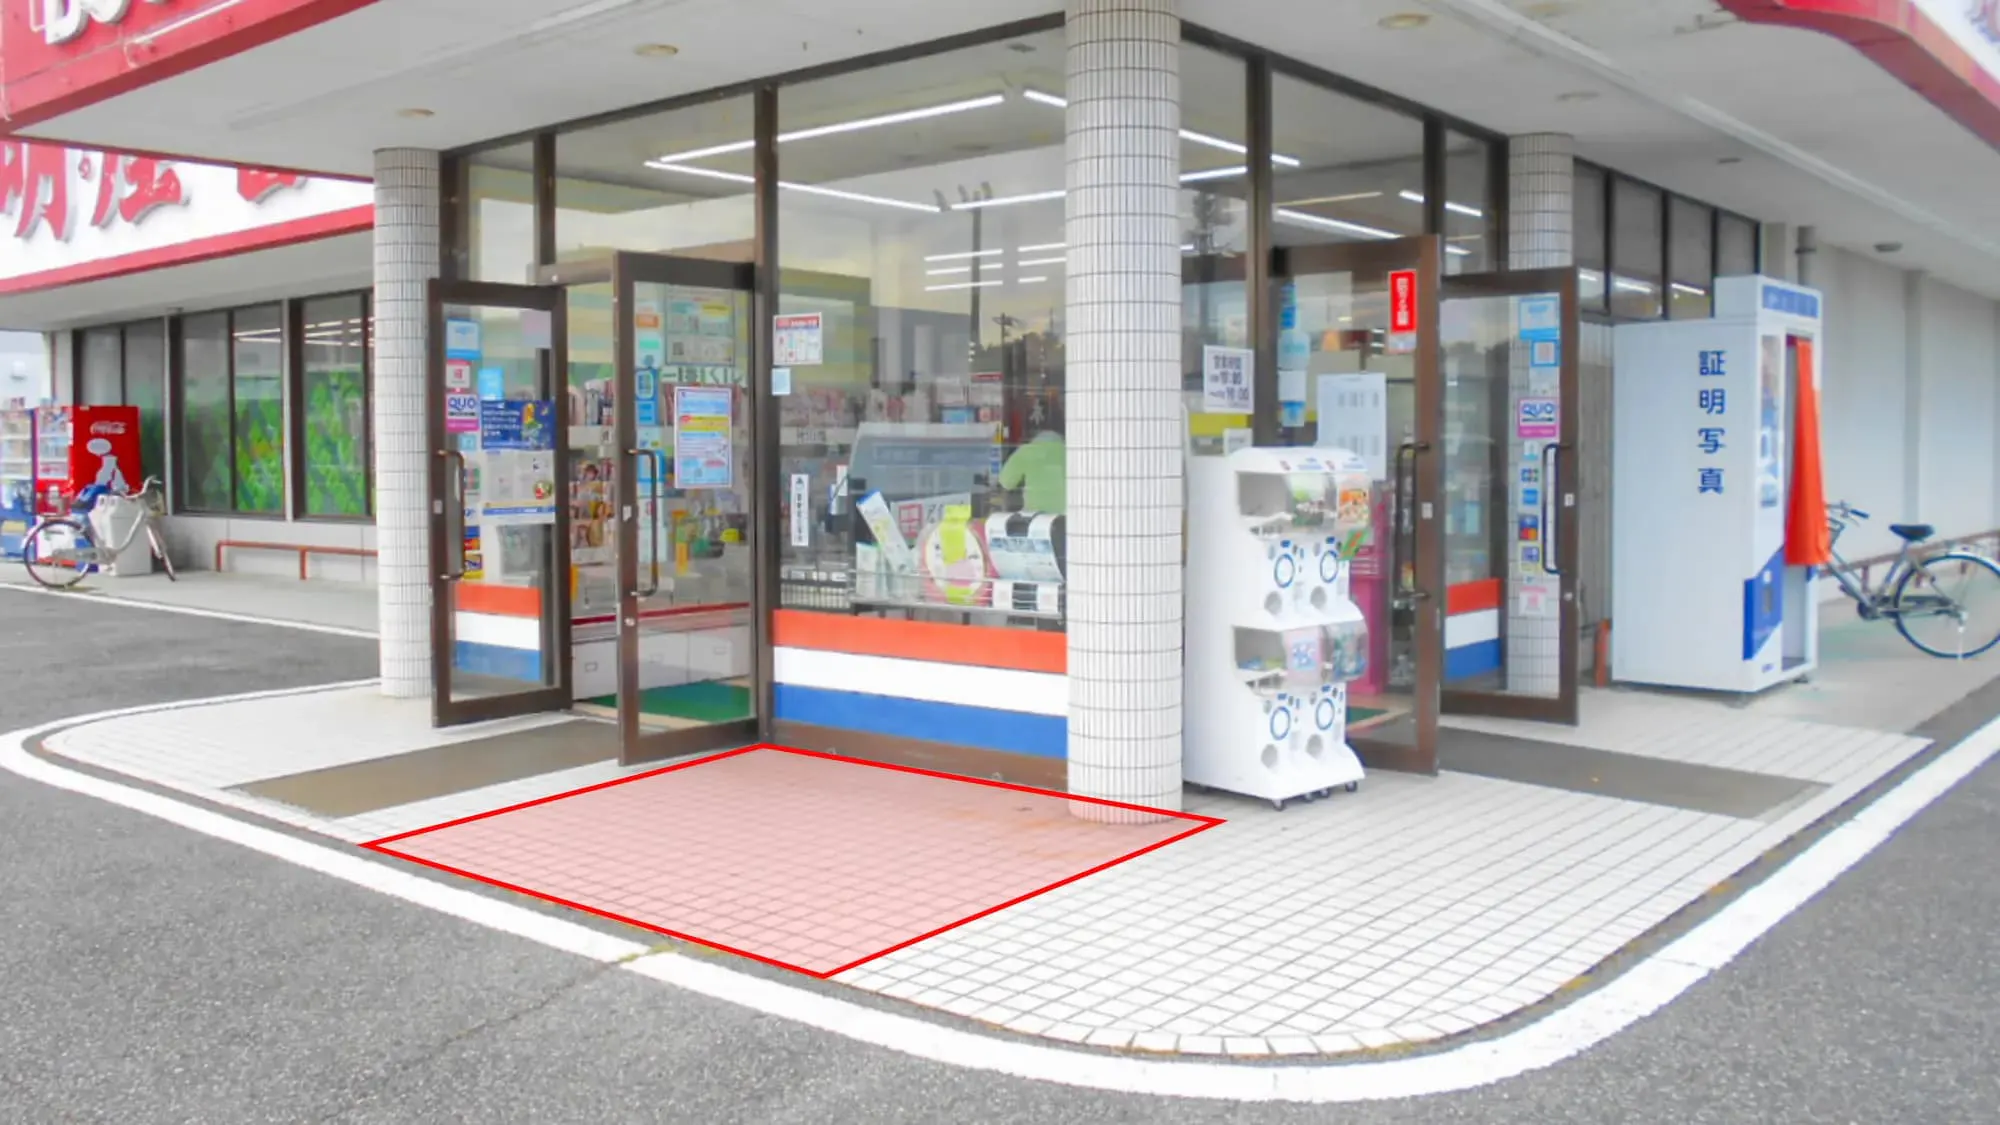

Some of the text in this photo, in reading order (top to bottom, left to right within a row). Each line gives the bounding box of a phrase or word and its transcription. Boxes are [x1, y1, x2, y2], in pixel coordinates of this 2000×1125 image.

[448, 397, 476, 411] QUO
[1522, 402, 1555, 417] QUO
[1697, 349, 1726, 494] 証明写真
